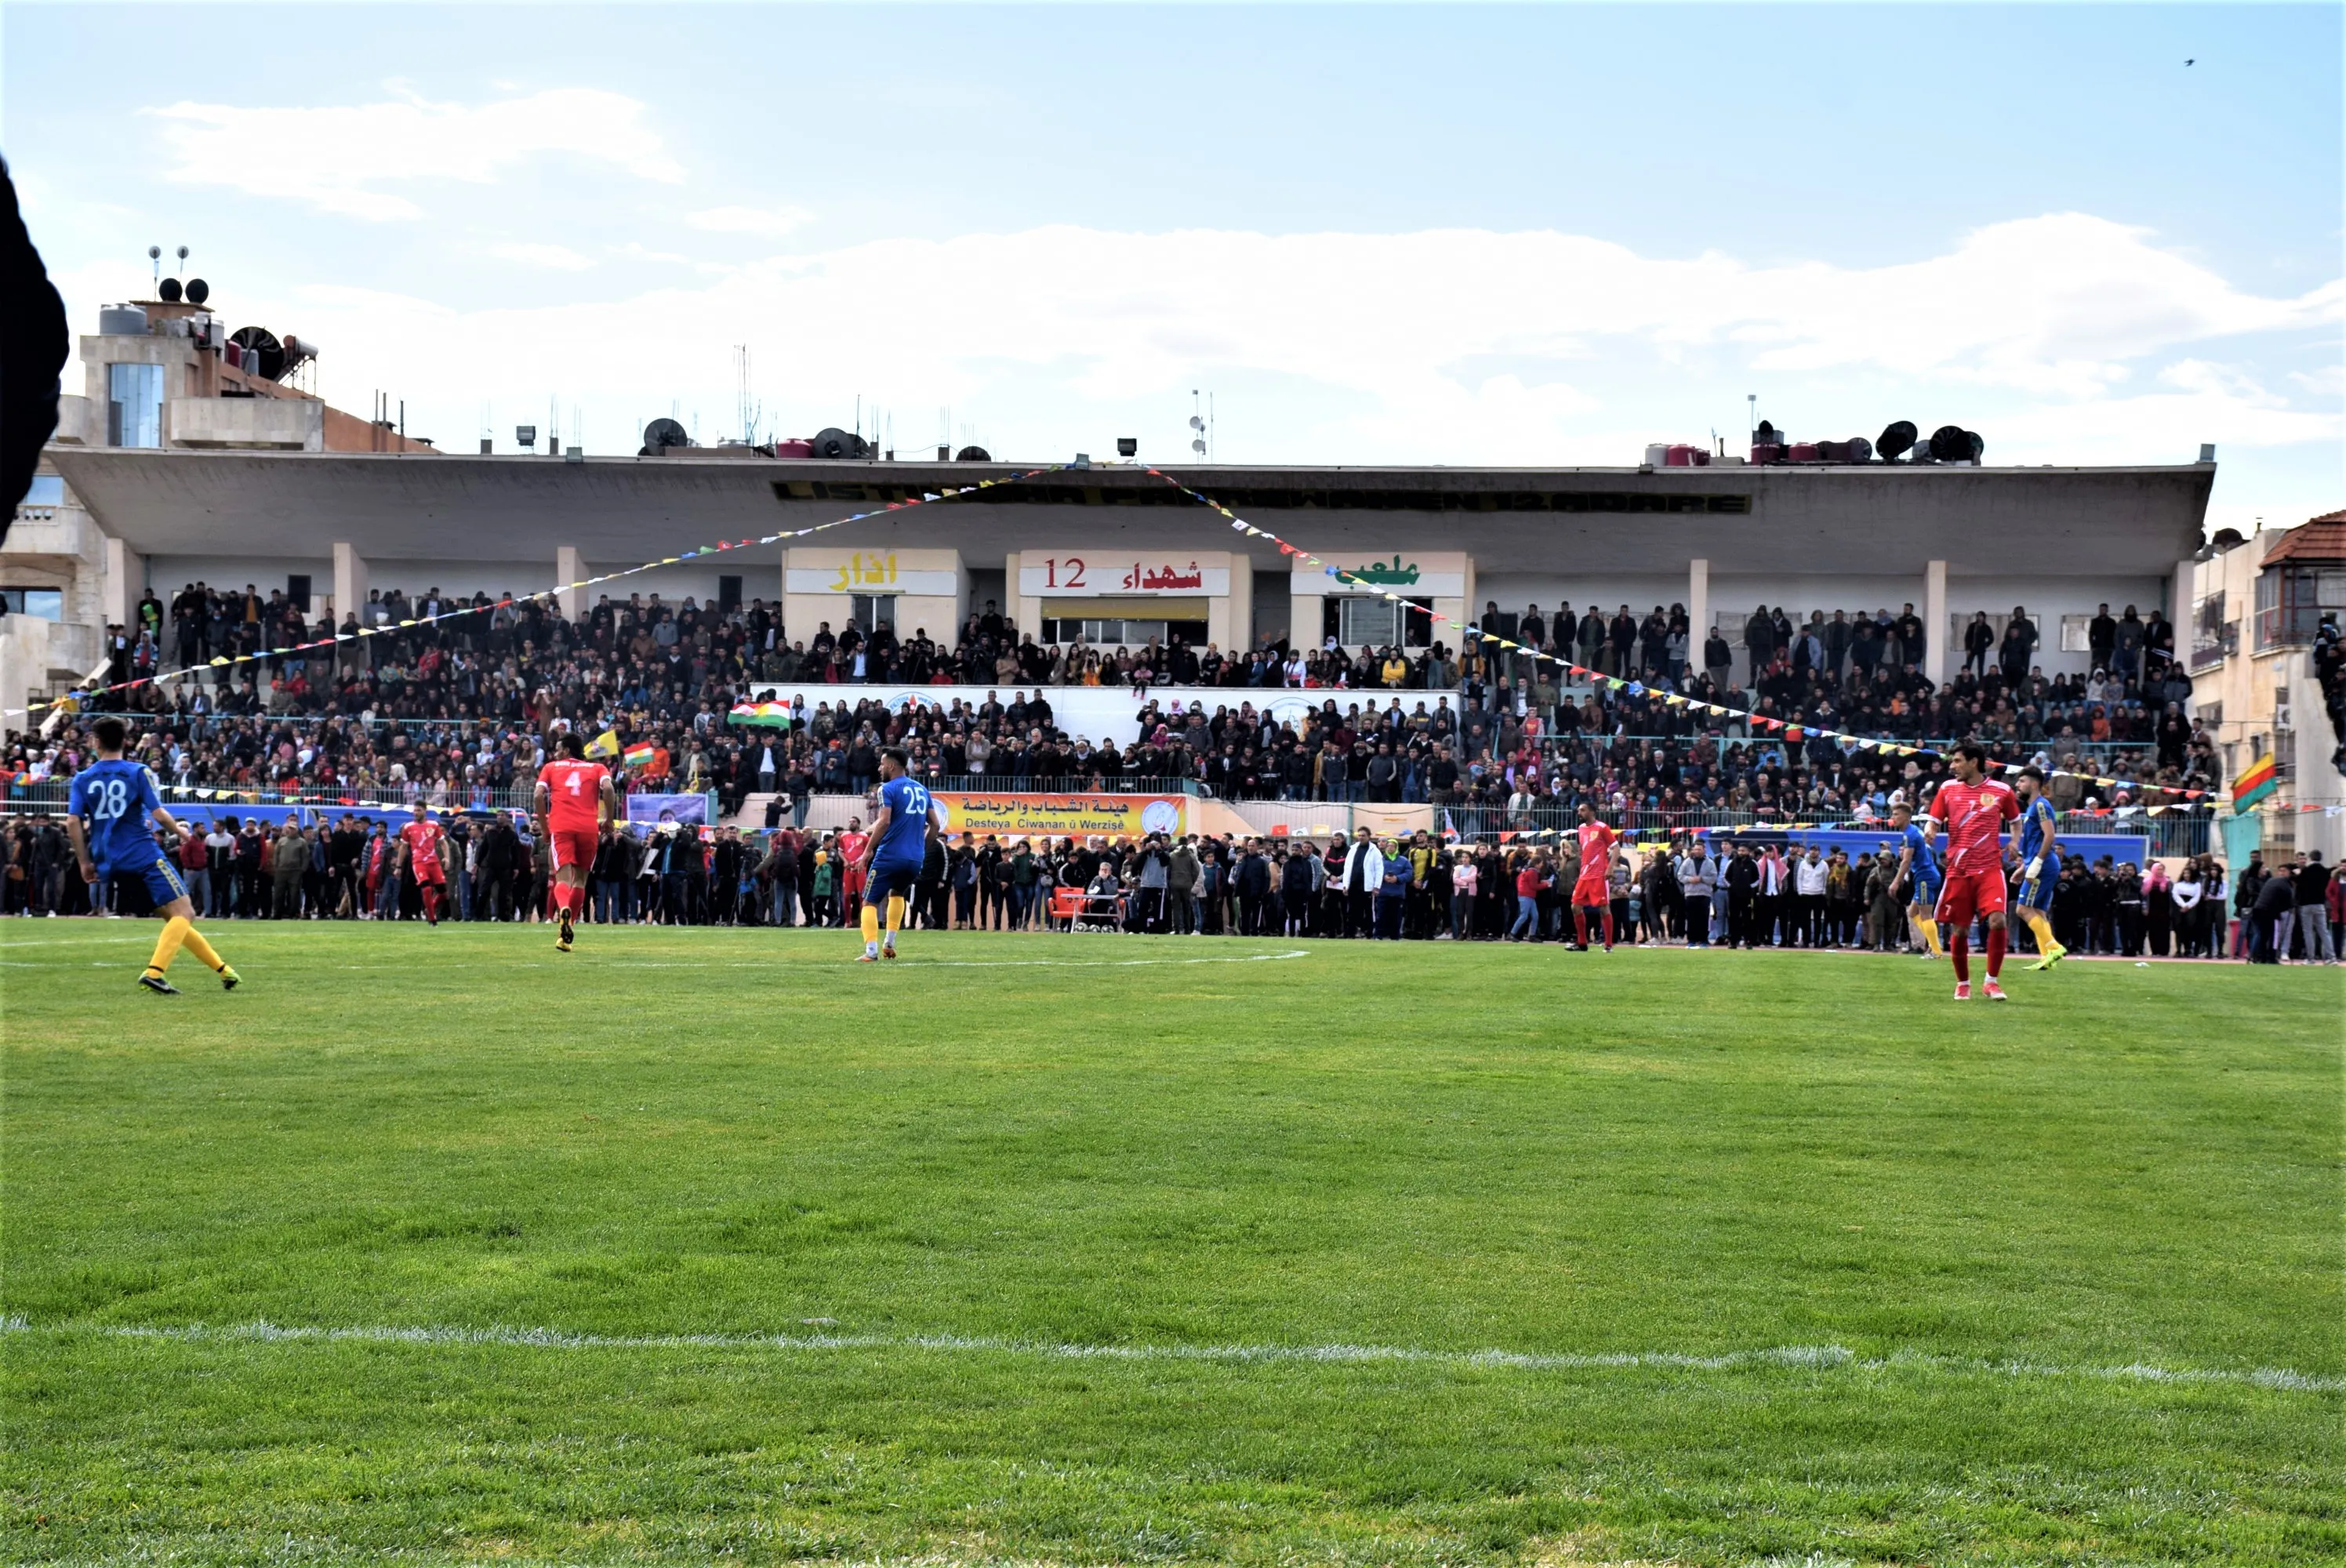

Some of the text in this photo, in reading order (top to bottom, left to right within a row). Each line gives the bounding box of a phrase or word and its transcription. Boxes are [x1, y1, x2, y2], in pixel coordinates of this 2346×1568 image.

[1044, 557, 1087, 588] 12
[1335, 554, 1421, 590] ملعب
[565, 771, 582, 797] 4
[88, 779, 127, 820] 28
[902, 786, 927, 815] 25
[962, 797, 1029, 815] والرياضة
[1032, 799, 1088, 815] الشباب
[965, 818, 1011, 829] Desteya
[1017, 818, 1066, 829] Ciwanan
[1945, 904, 1952, 916] 7
